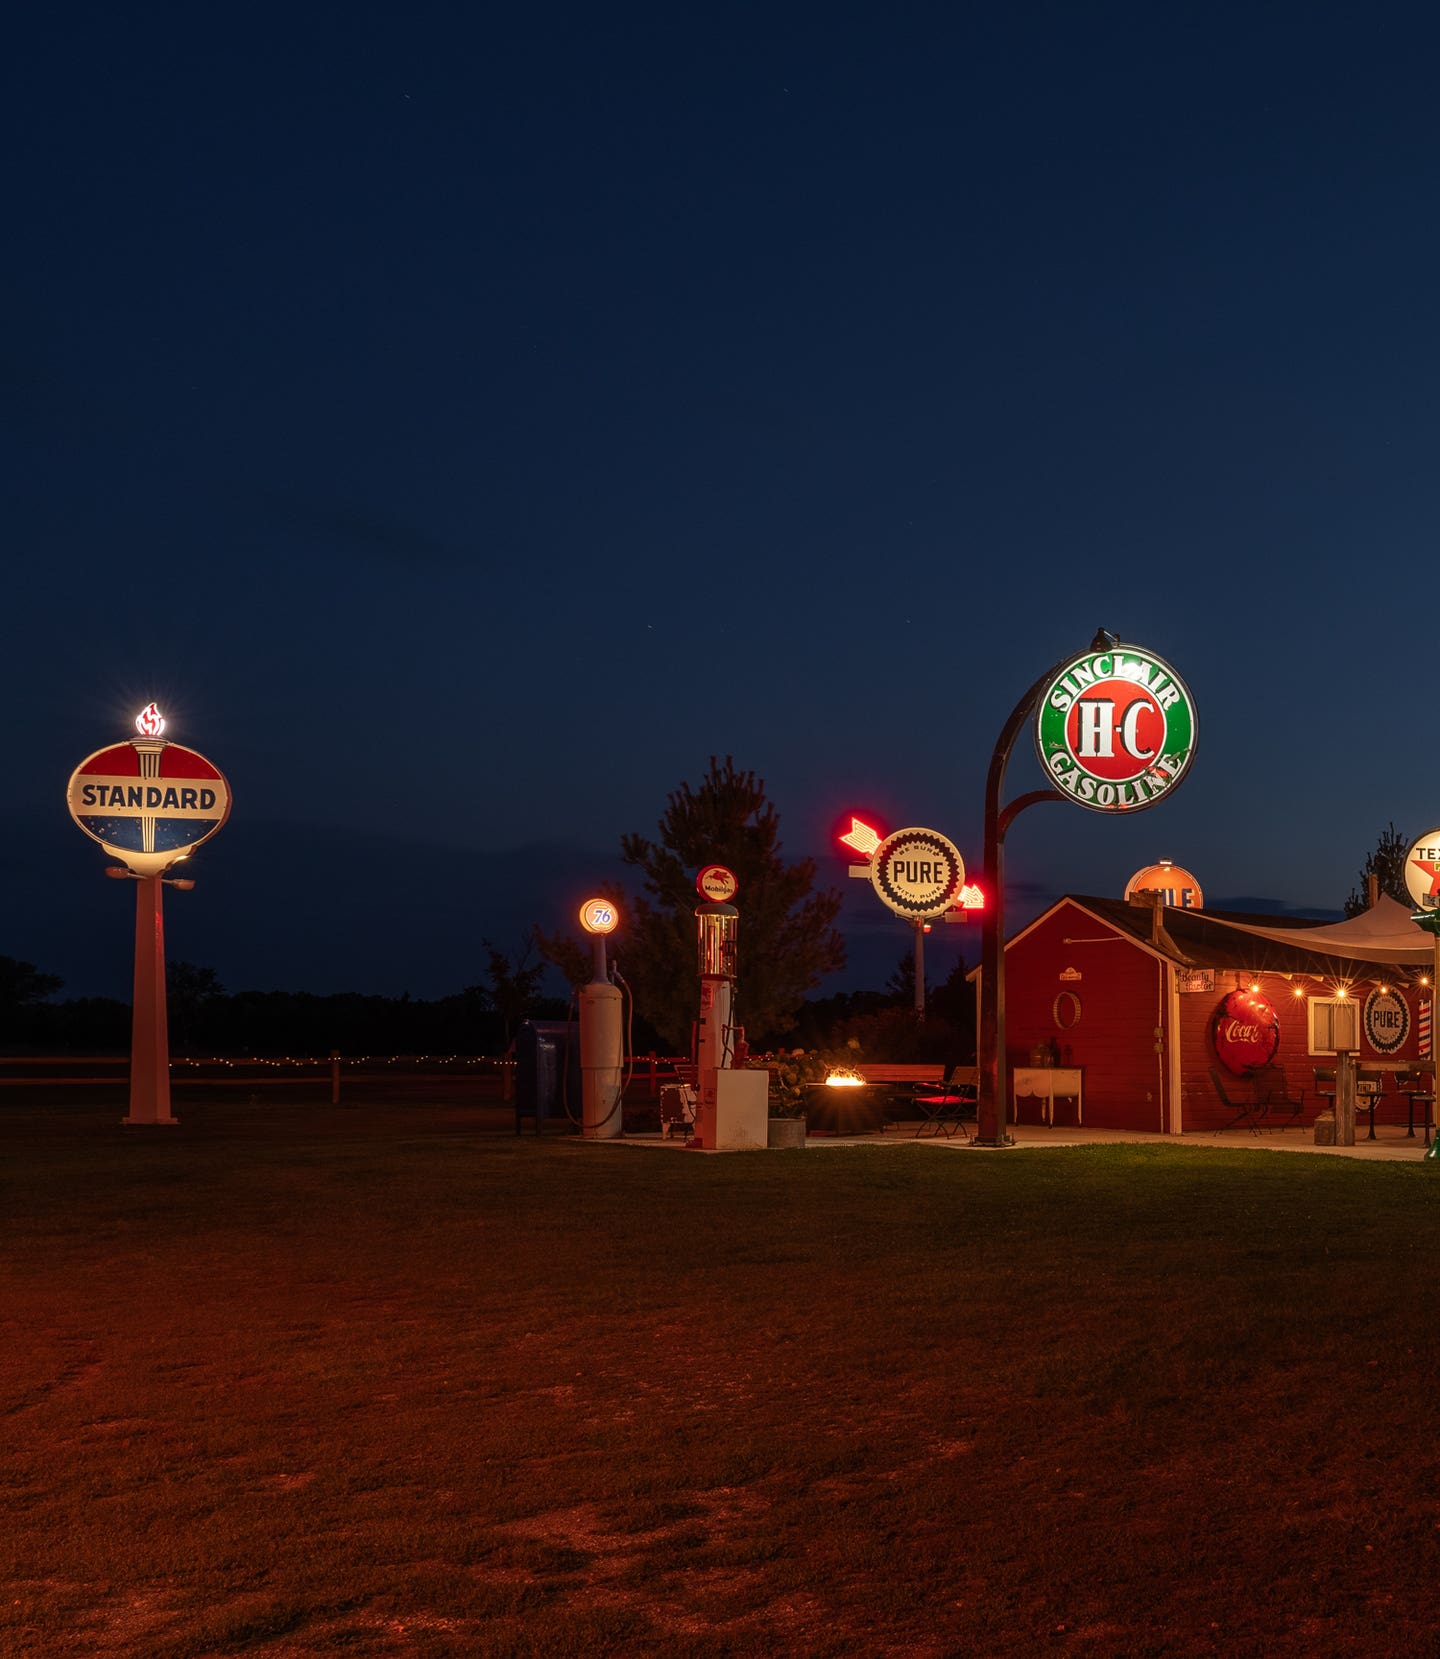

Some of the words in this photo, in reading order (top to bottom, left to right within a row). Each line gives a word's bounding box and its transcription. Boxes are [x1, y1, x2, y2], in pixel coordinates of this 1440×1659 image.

[1050, 655, 1181, 712] SINCLAIR
[1077, 700, 1155, 760] H-C
[1050, 752, 1182, 806] GASOLINE
[82, 784, 216, 810] STANDARD
[898, 847, 910, 856] BE
[893, 860, 943, 883] PURE
[592, 908, 611, 924] 76
[1373, 1010, 1400, 1028] PURE
